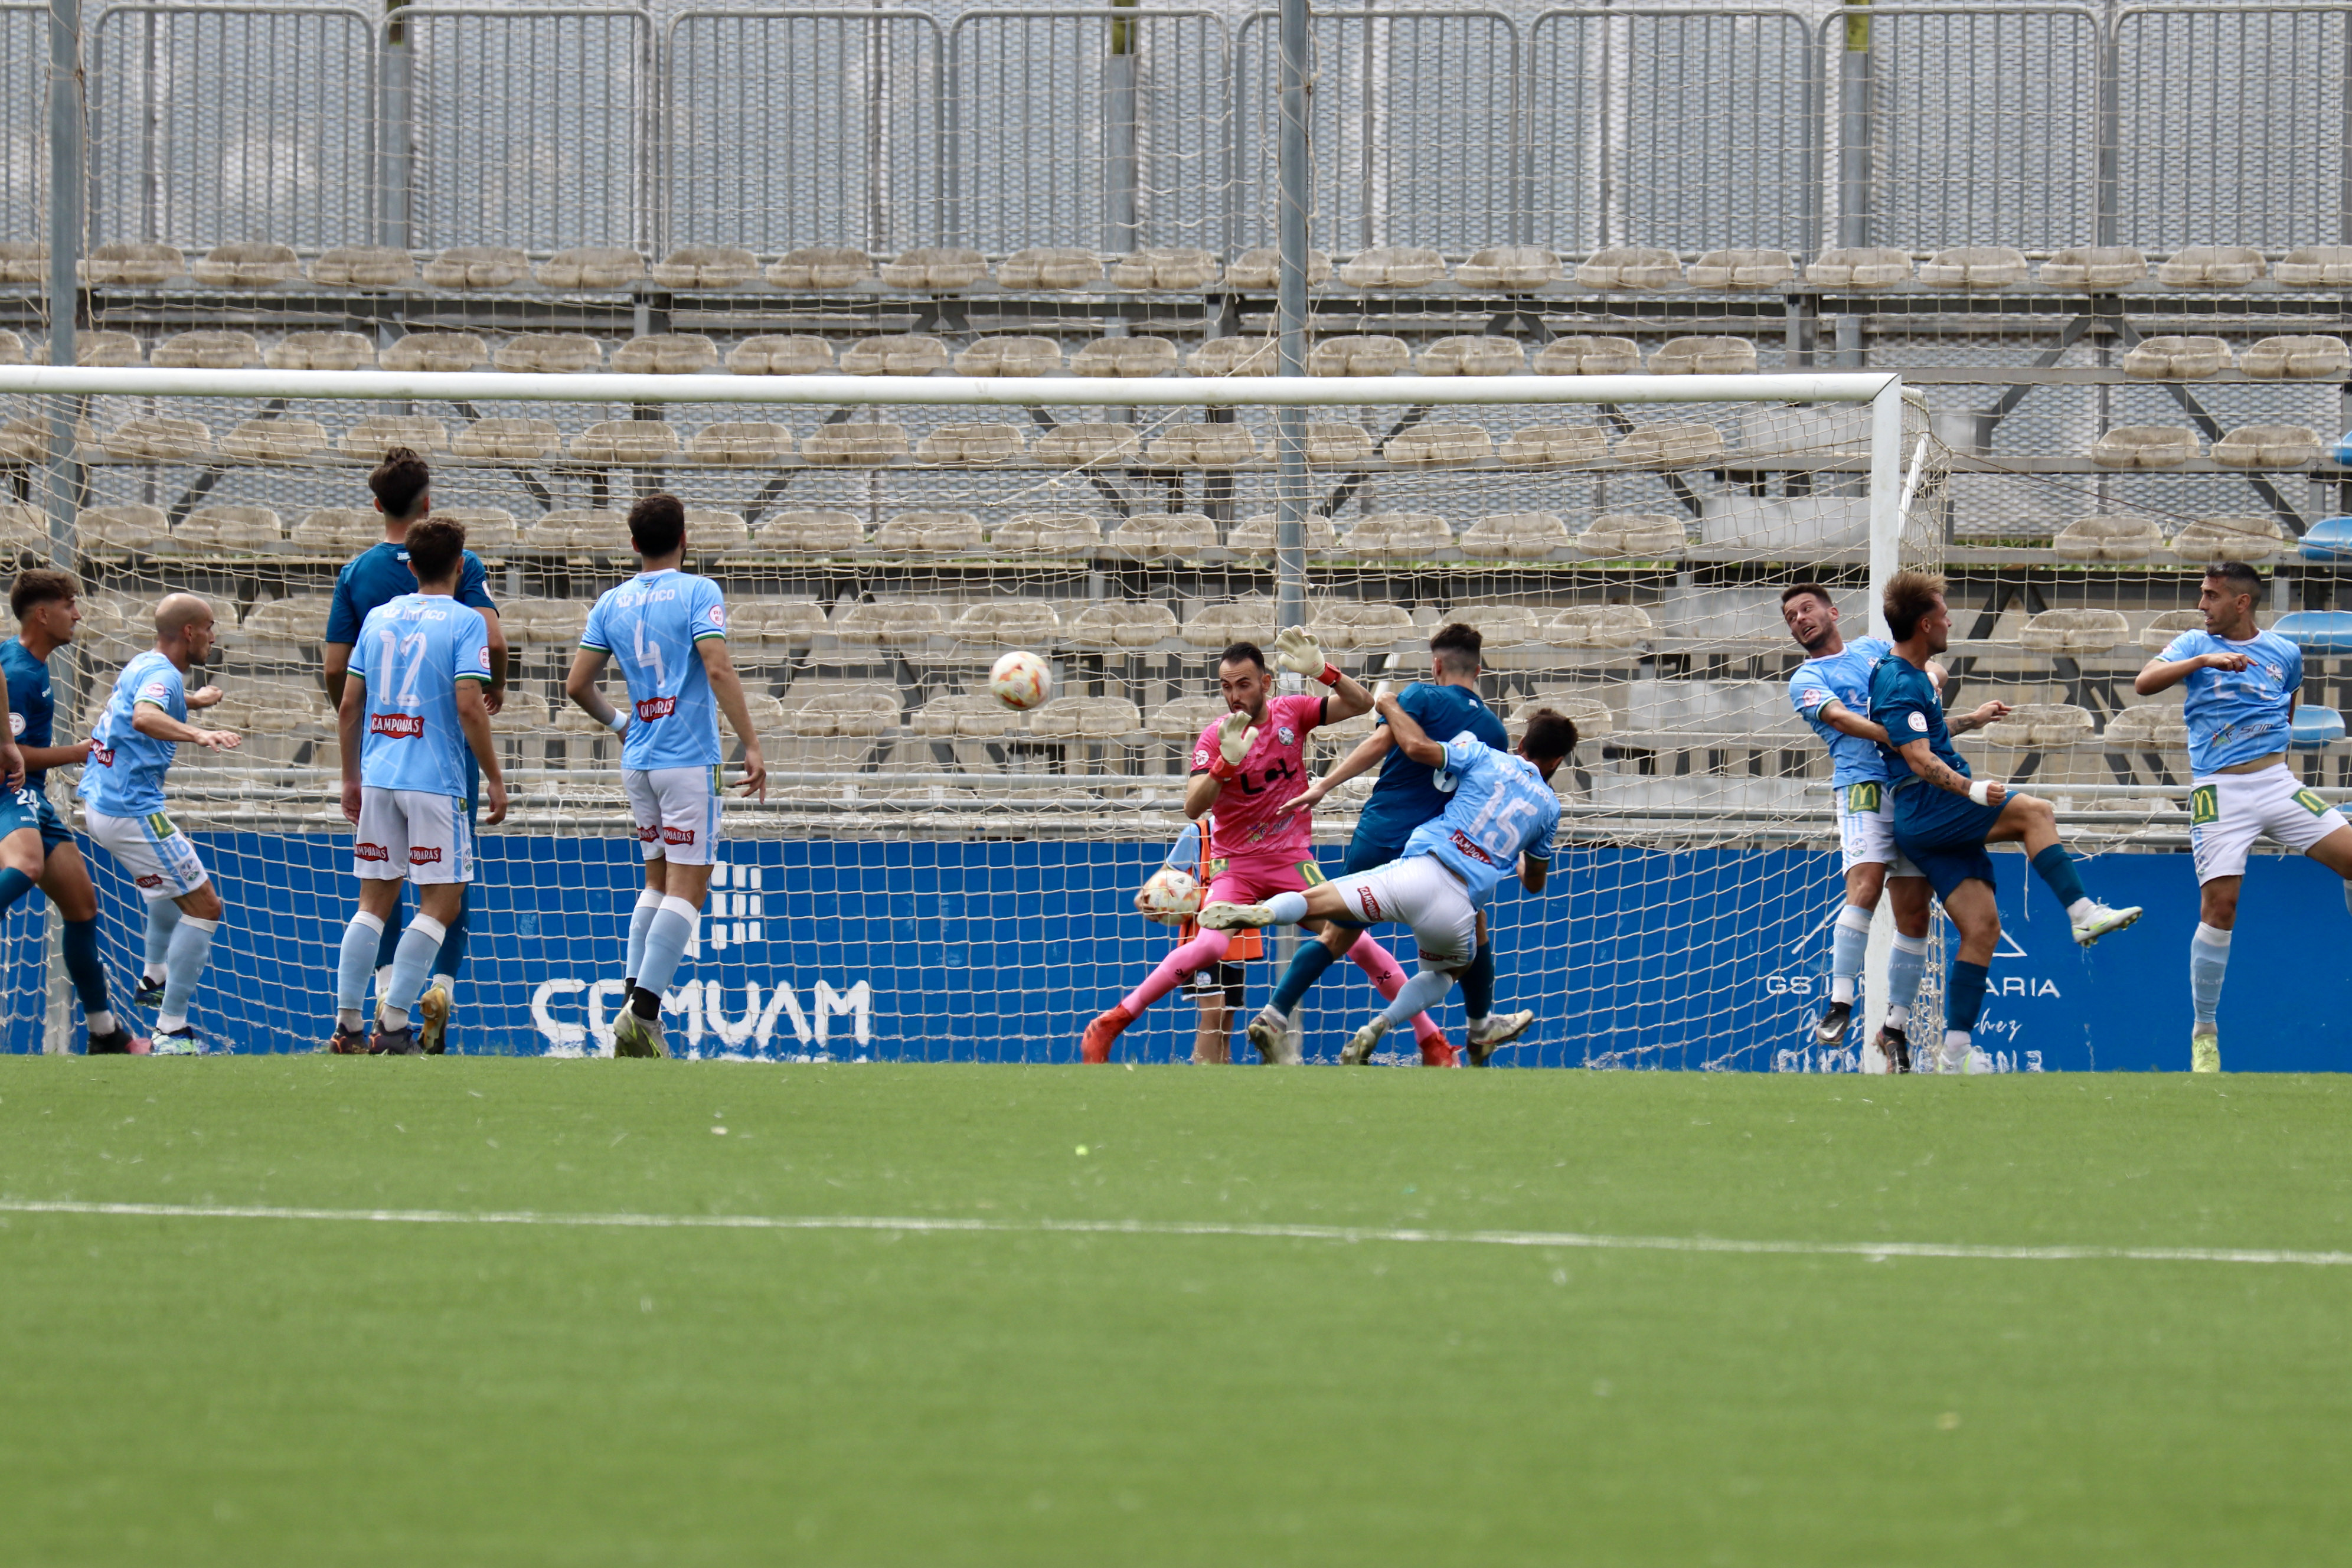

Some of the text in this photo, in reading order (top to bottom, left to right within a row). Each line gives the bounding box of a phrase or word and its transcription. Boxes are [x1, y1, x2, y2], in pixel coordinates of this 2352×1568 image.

[379, 631, 427, 707] 12
[634, 619, 665, 688] 4
[1469, 780, 1538, 858] 15
[1766, 976, 1812, 995] GS
